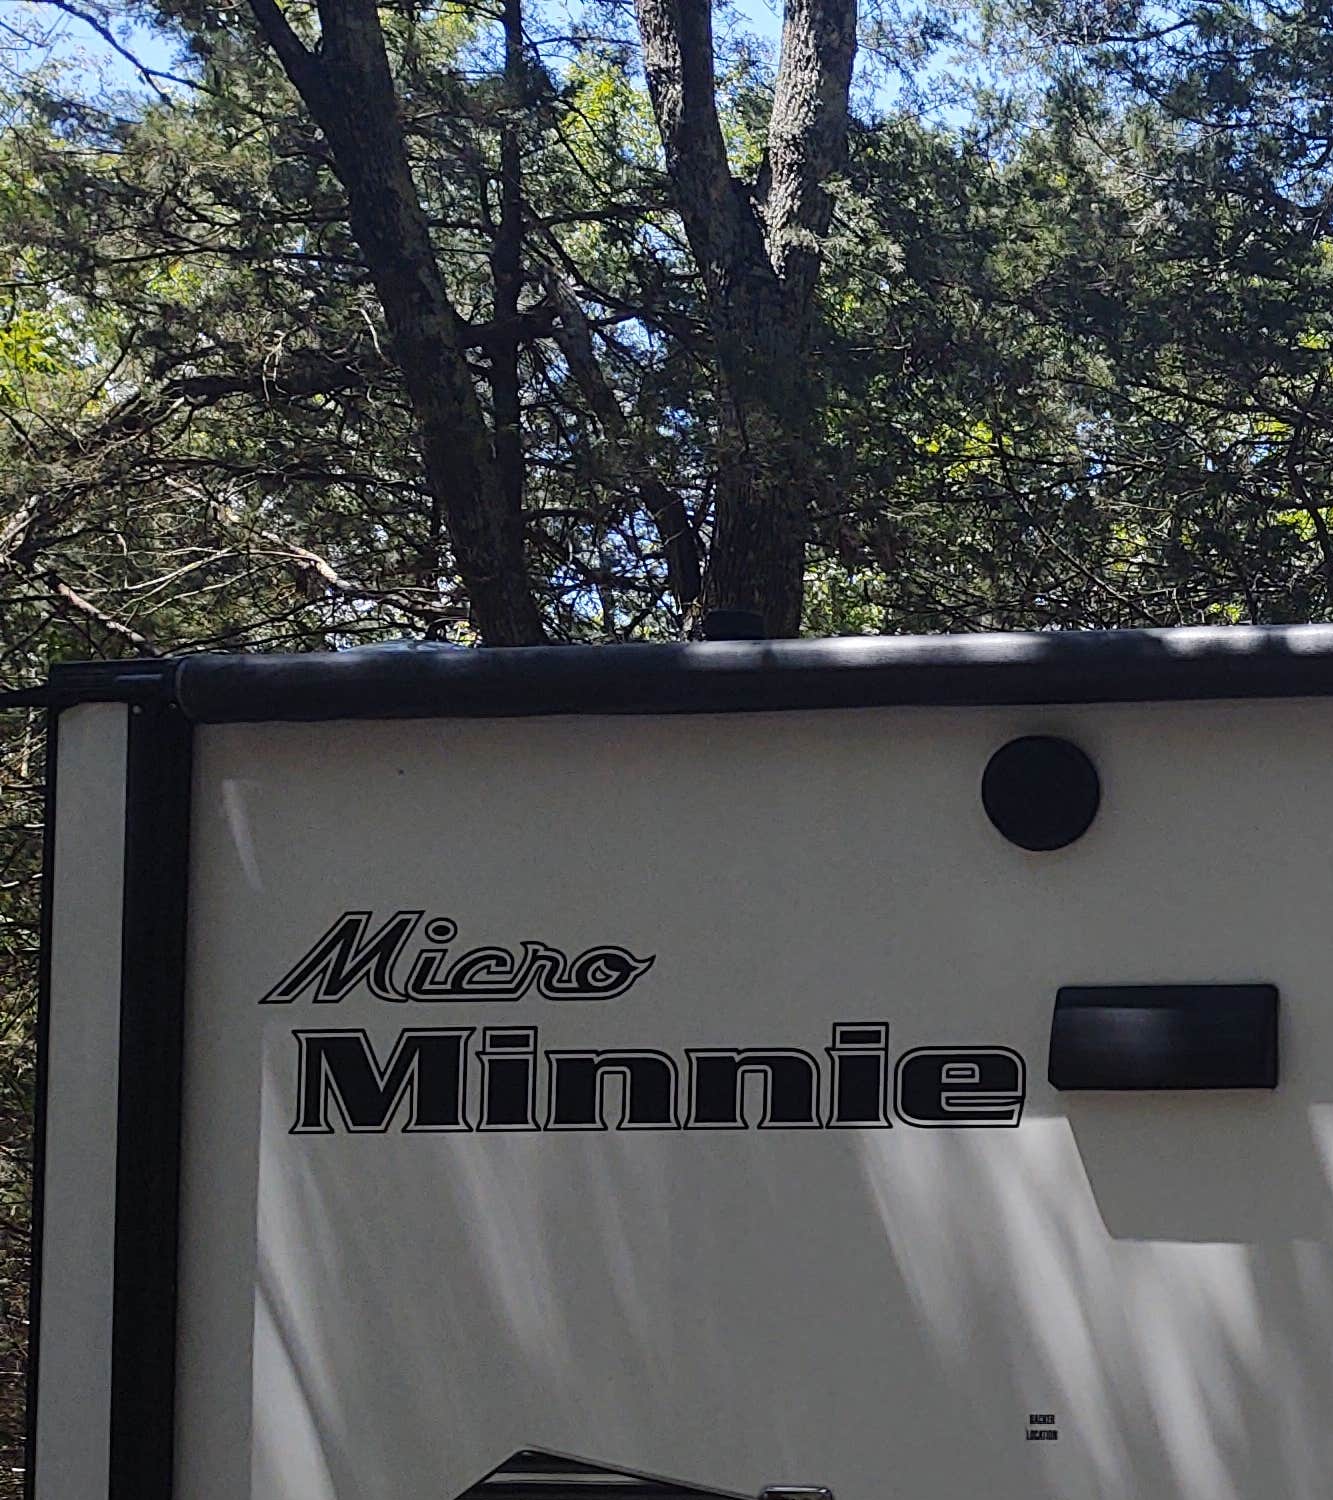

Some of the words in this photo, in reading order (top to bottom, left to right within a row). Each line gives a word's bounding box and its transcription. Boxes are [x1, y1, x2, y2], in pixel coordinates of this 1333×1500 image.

[258, 910, 656, 1004] Micro
[289, 1021, 1027, 1135] Minnie
[1026, 1430, 1058, 1441] LOCATION
